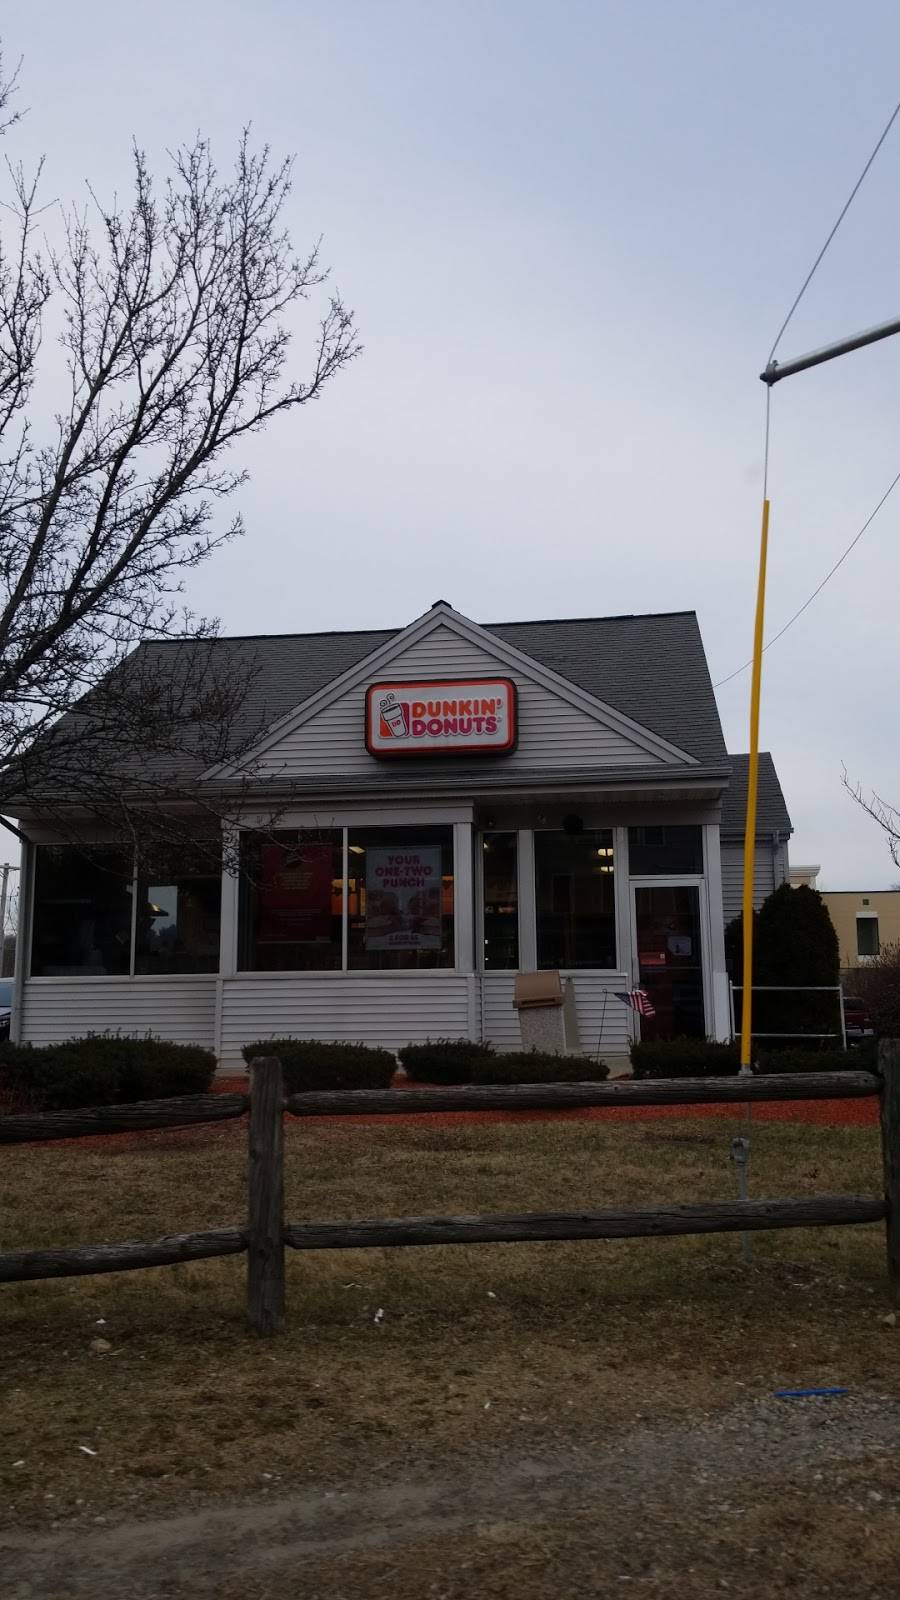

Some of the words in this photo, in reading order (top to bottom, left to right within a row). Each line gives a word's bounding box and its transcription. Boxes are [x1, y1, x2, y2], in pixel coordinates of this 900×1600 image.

[412, 699, 501, 718] DUNKIN'
[412, 717, 497, 736] DONUTS
[388, 855, 420, 865] YOUR
[375, 866, 432, 877] ONE-TWO
[383, 878, 424, 888] PUNCH
